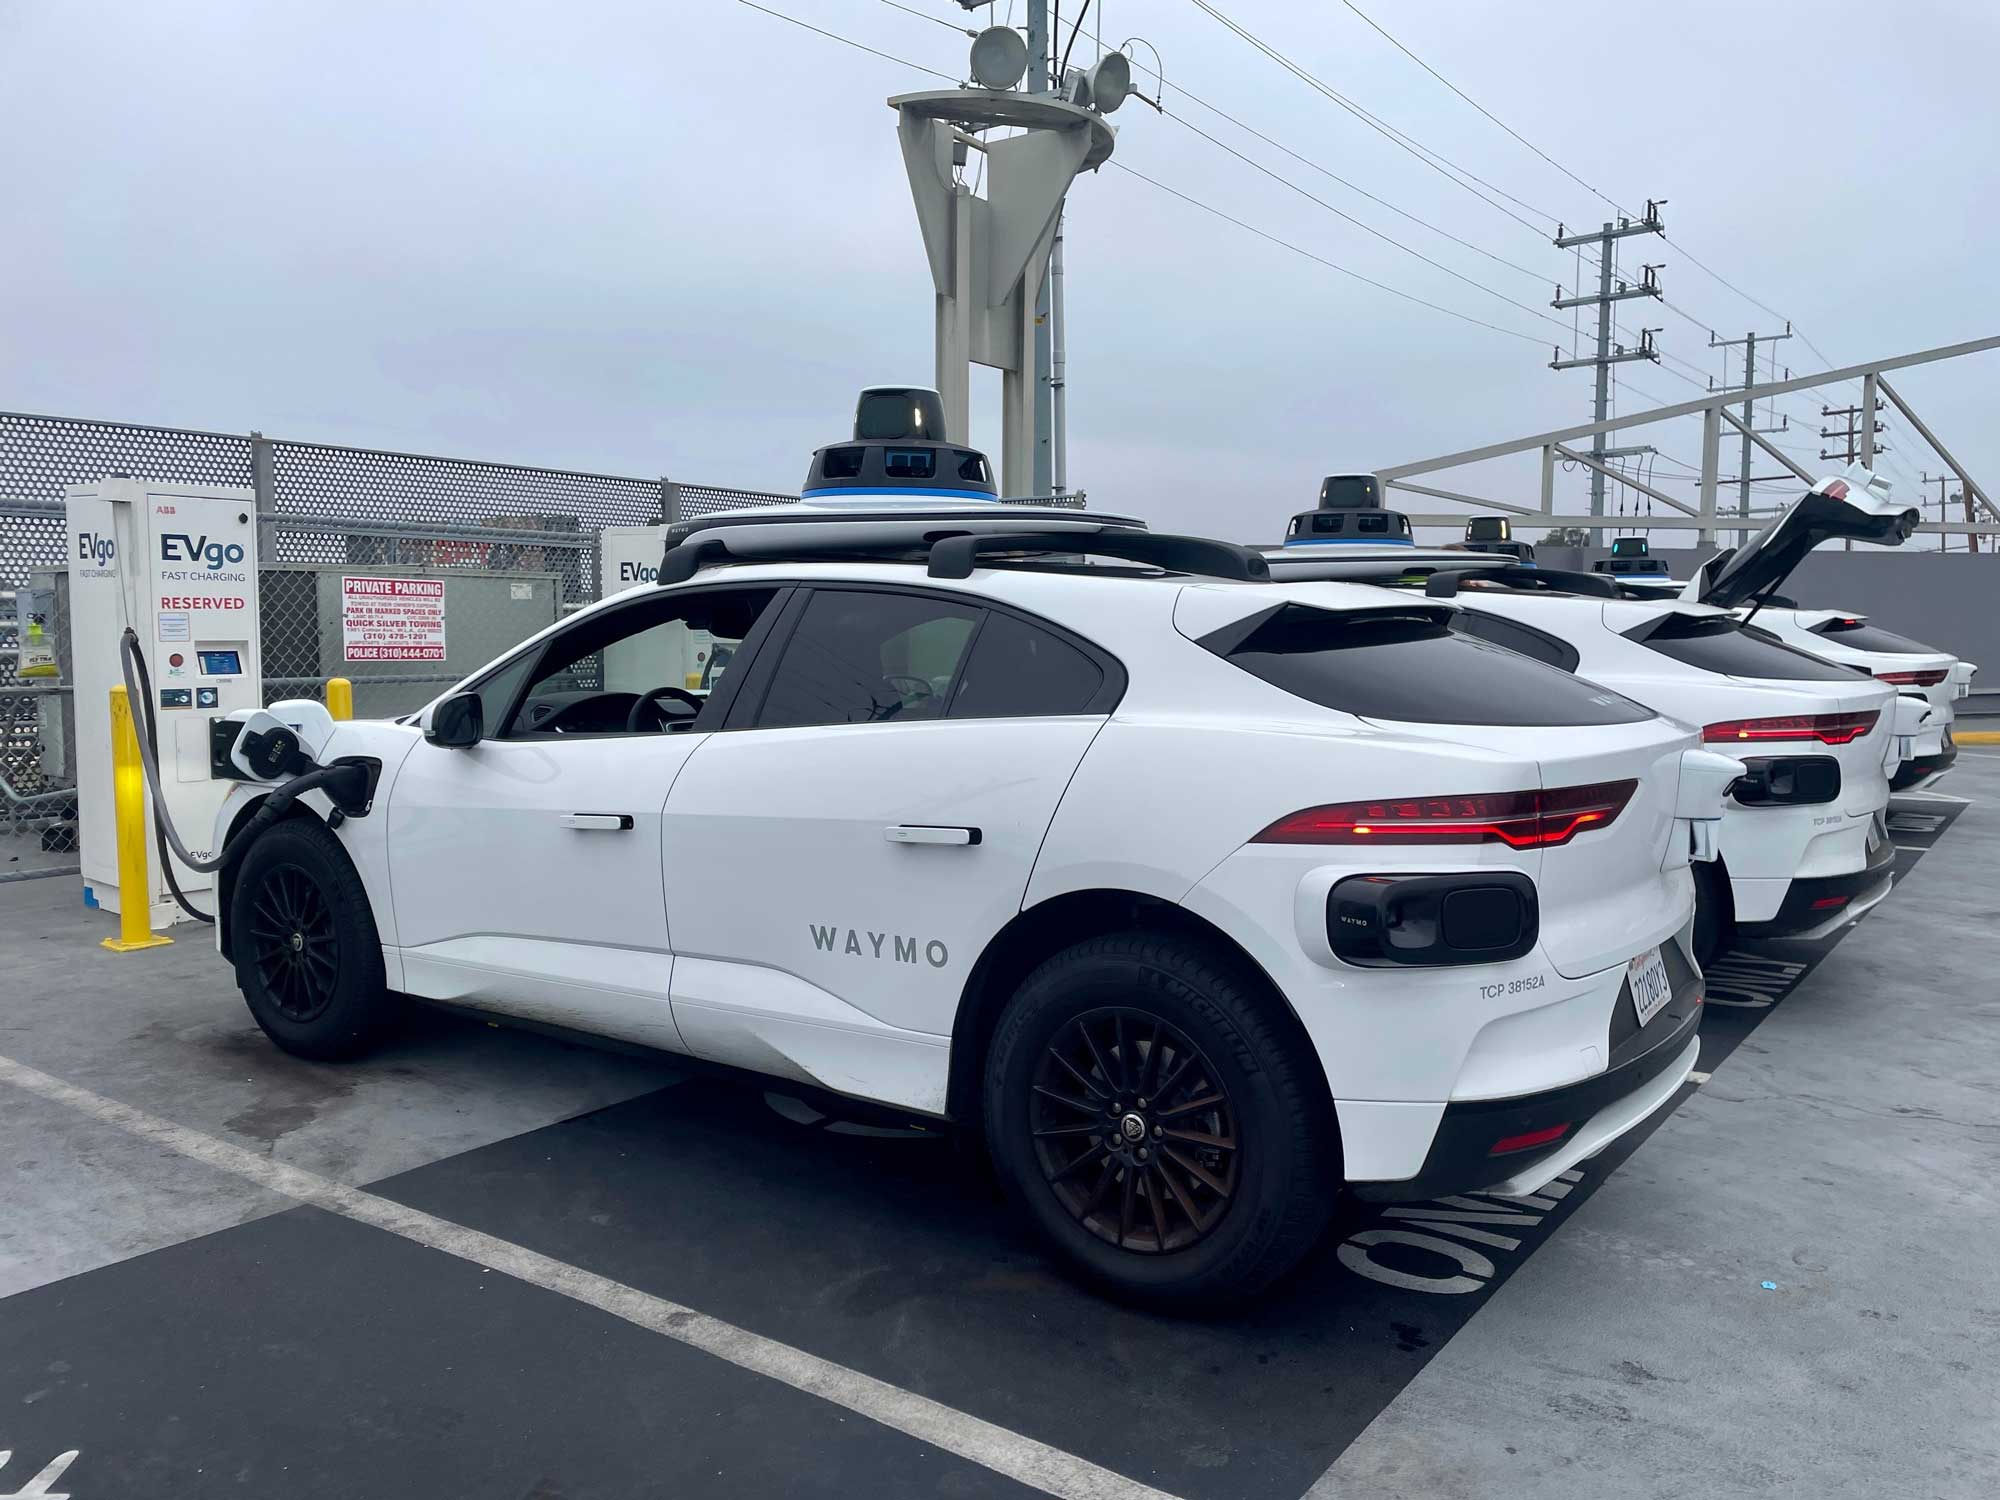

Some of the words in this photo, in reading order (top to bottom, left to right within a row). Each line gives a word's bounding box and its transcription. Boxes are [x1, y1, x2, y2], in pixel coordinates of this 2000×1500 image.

[156, 506, 176, 514] ABB
[78, 532, 114, 566] EVgo
[160, 534, 244, 570] EVgo
[162, 572, 187, 580] FAST
[190, 572, 246, 582] CHARGING
[620, 562, 658, 582] EVgo
[346, 580, 392, 594] PRIVATE
[394, 582, 441, 595] PARKING
[162, 597, 244, 610] RESERVED
[348, 648, 378, 657] POLICE
[1341, 916, 1367, 926] WAYMO
[809, 924, 948, 968] WAYMO
[1480, 984, 1505, 1000] TCP
[1508, 976, 1545, 994] 38152A
[1634, 960, 1668, 1014] 22180Y3
